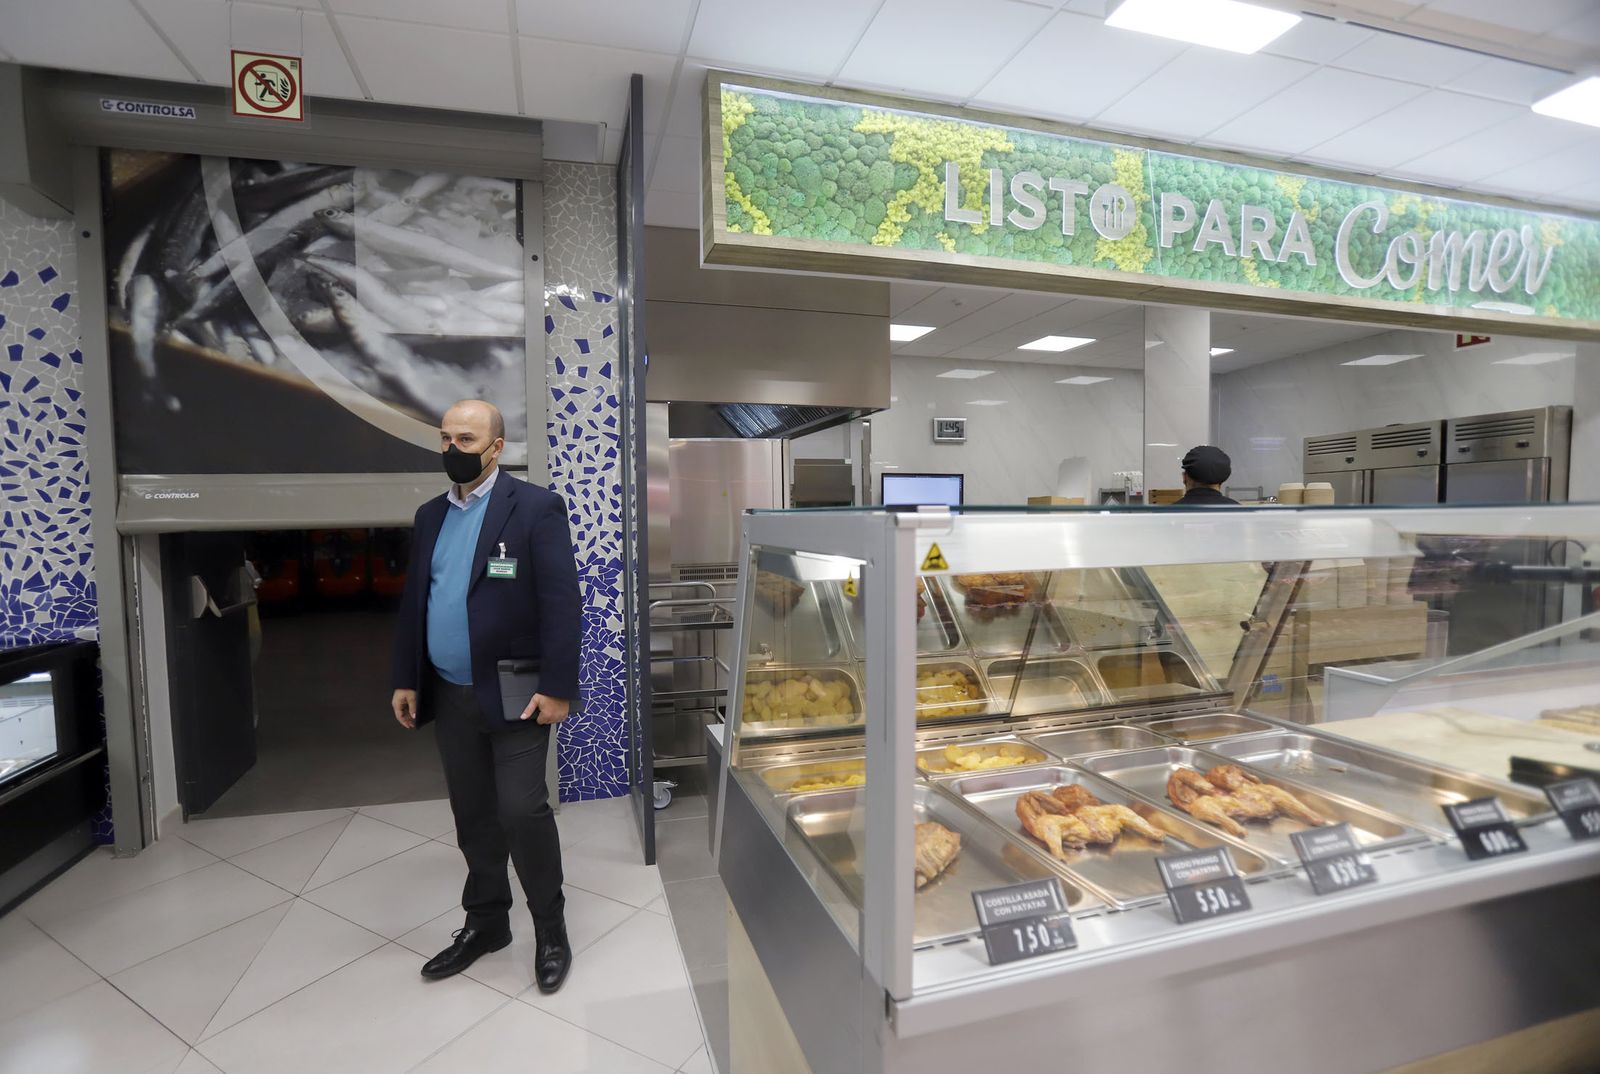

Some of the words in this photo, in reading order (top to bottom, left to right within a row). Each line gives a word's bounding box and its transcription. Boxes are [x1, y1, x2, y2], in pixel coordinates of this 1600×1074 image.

[116, 101, 195, 118] CONTROLSA
[944, 161, 1137, 241] LISTO
[1160, 191, 1318, 267] PARA
[1335, 199, 1553, 296] Comer
[984, 893, 1023, 908] COSTILLA
[1023, 887, 1051, 902] ASADA
[993, 904, 1012, 917] CON
[1011, 899, 1048, 914] PATATAS
